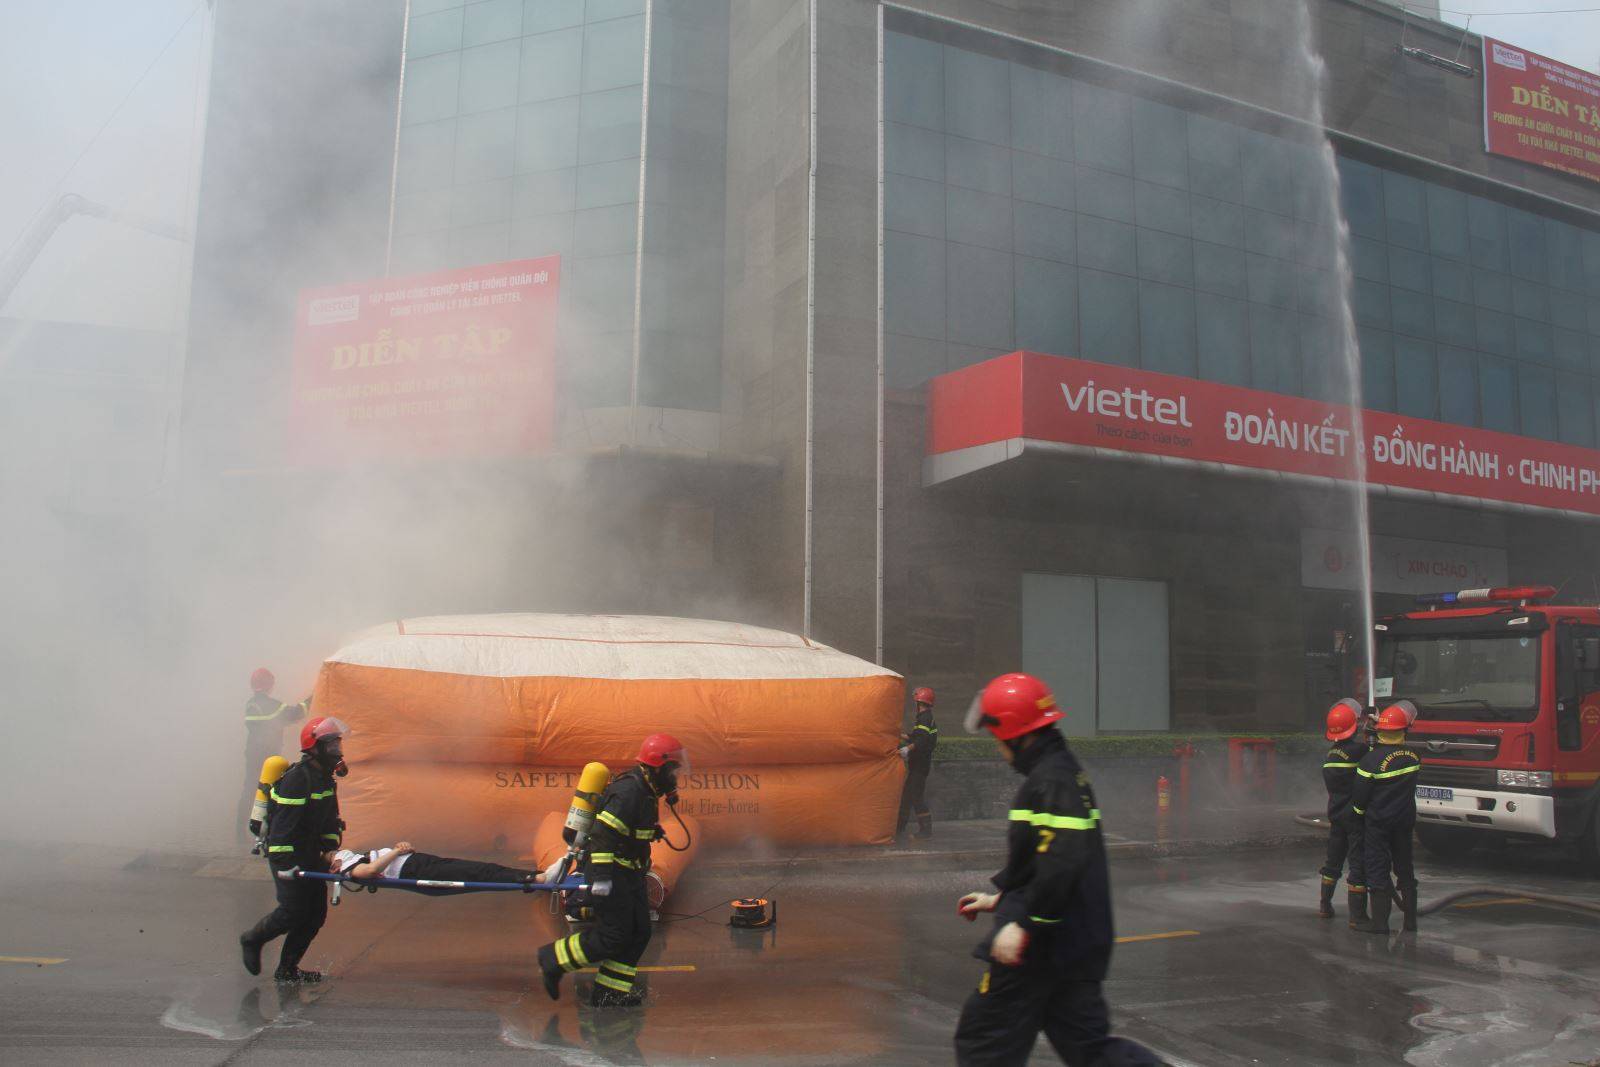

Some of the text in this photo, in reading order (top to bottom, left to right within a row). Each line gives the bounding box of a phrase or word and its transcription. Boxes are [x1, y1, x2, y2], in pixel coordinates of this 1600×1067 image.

[1512, 85, 1569, 117] DIỄN
[331, 328, 423, 370] DIỄN
[1060, 380, 1193, 428] viettel
[1096, 423, 1122, 438] Theo
[1224, 407, 1298, 450] ĐOÀN
[1304, 412, 1350, 456] KẾT
[1372, 423, 1437, 470] ĐỒNG
[1440, 440, 1499, 480] HÀNH
[1519, 458, 1575, 492] CHINH
[1408, 559, 1430, 575] XIN
[495, 771, 760, 790] SAFET USHION
